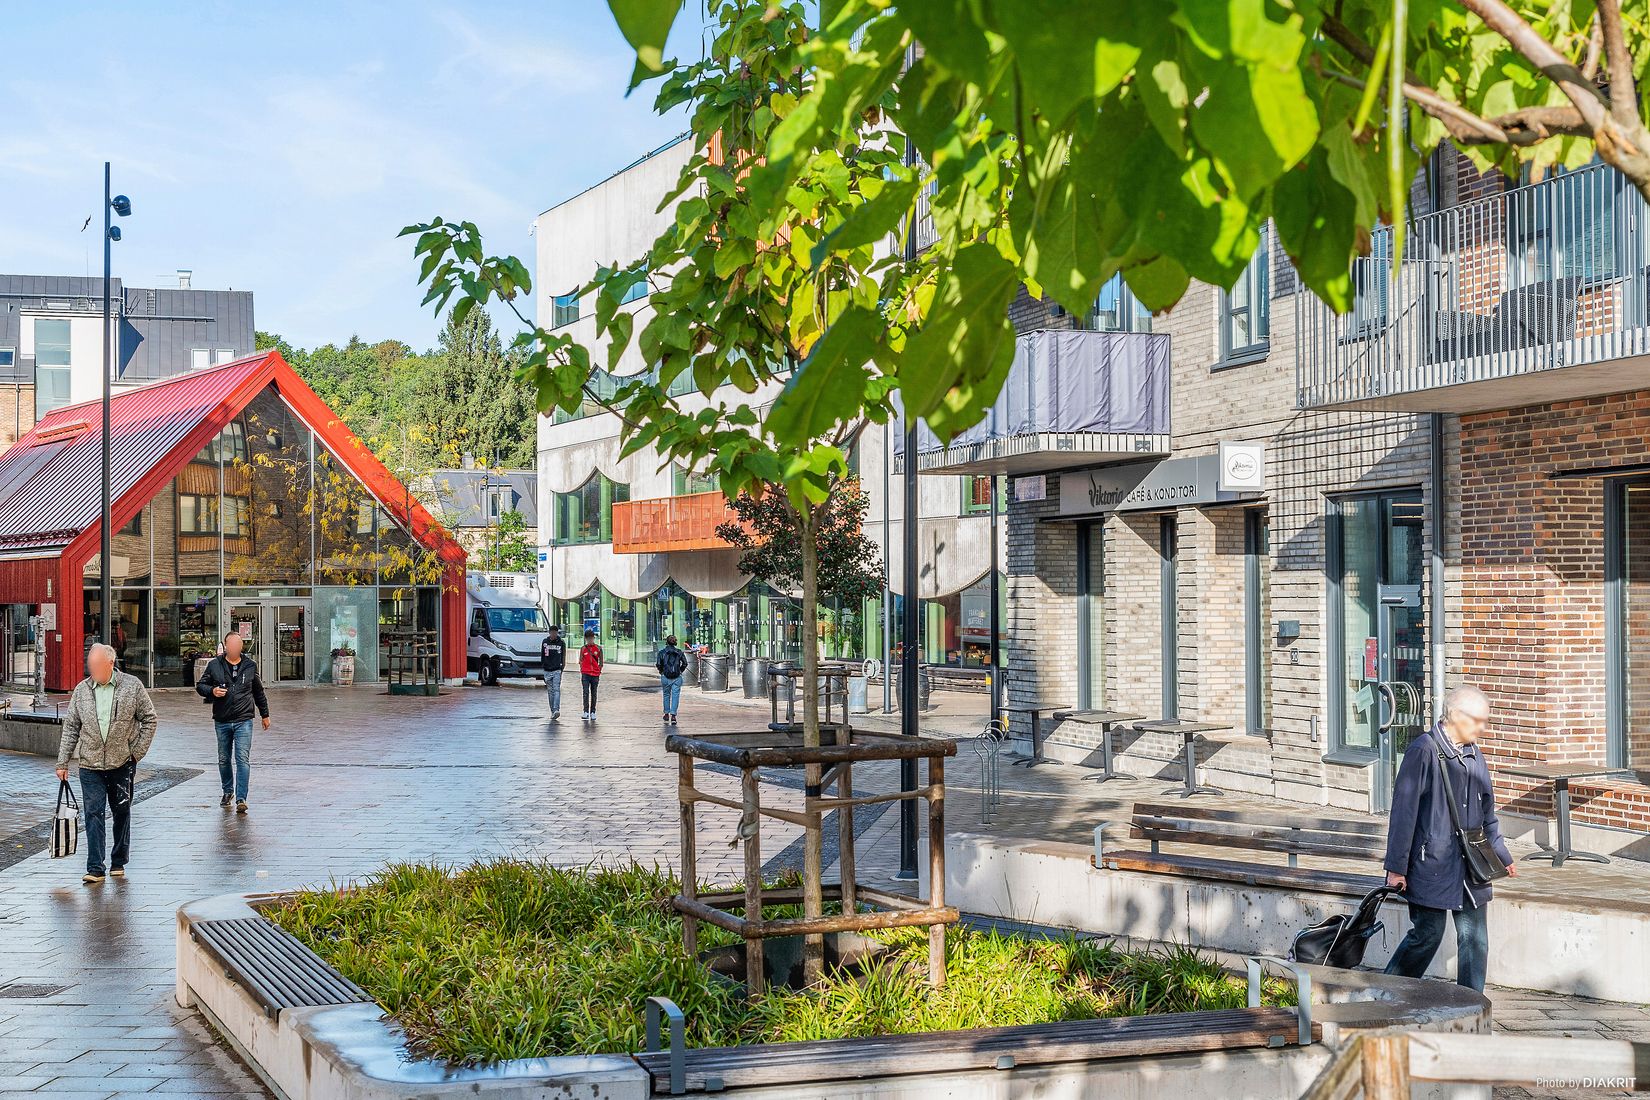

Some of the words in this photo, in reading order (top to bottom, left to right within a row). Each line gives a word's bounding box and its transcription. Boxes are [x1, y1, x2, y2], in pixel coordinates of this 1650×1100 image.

[1088, 473, 1124, 508] Viktoria
[1126, 486, 1145, 503] CAFÉ
[1147, 489, 1153, 501] &
[1154, 484, 1197, 500] KONDITORI
